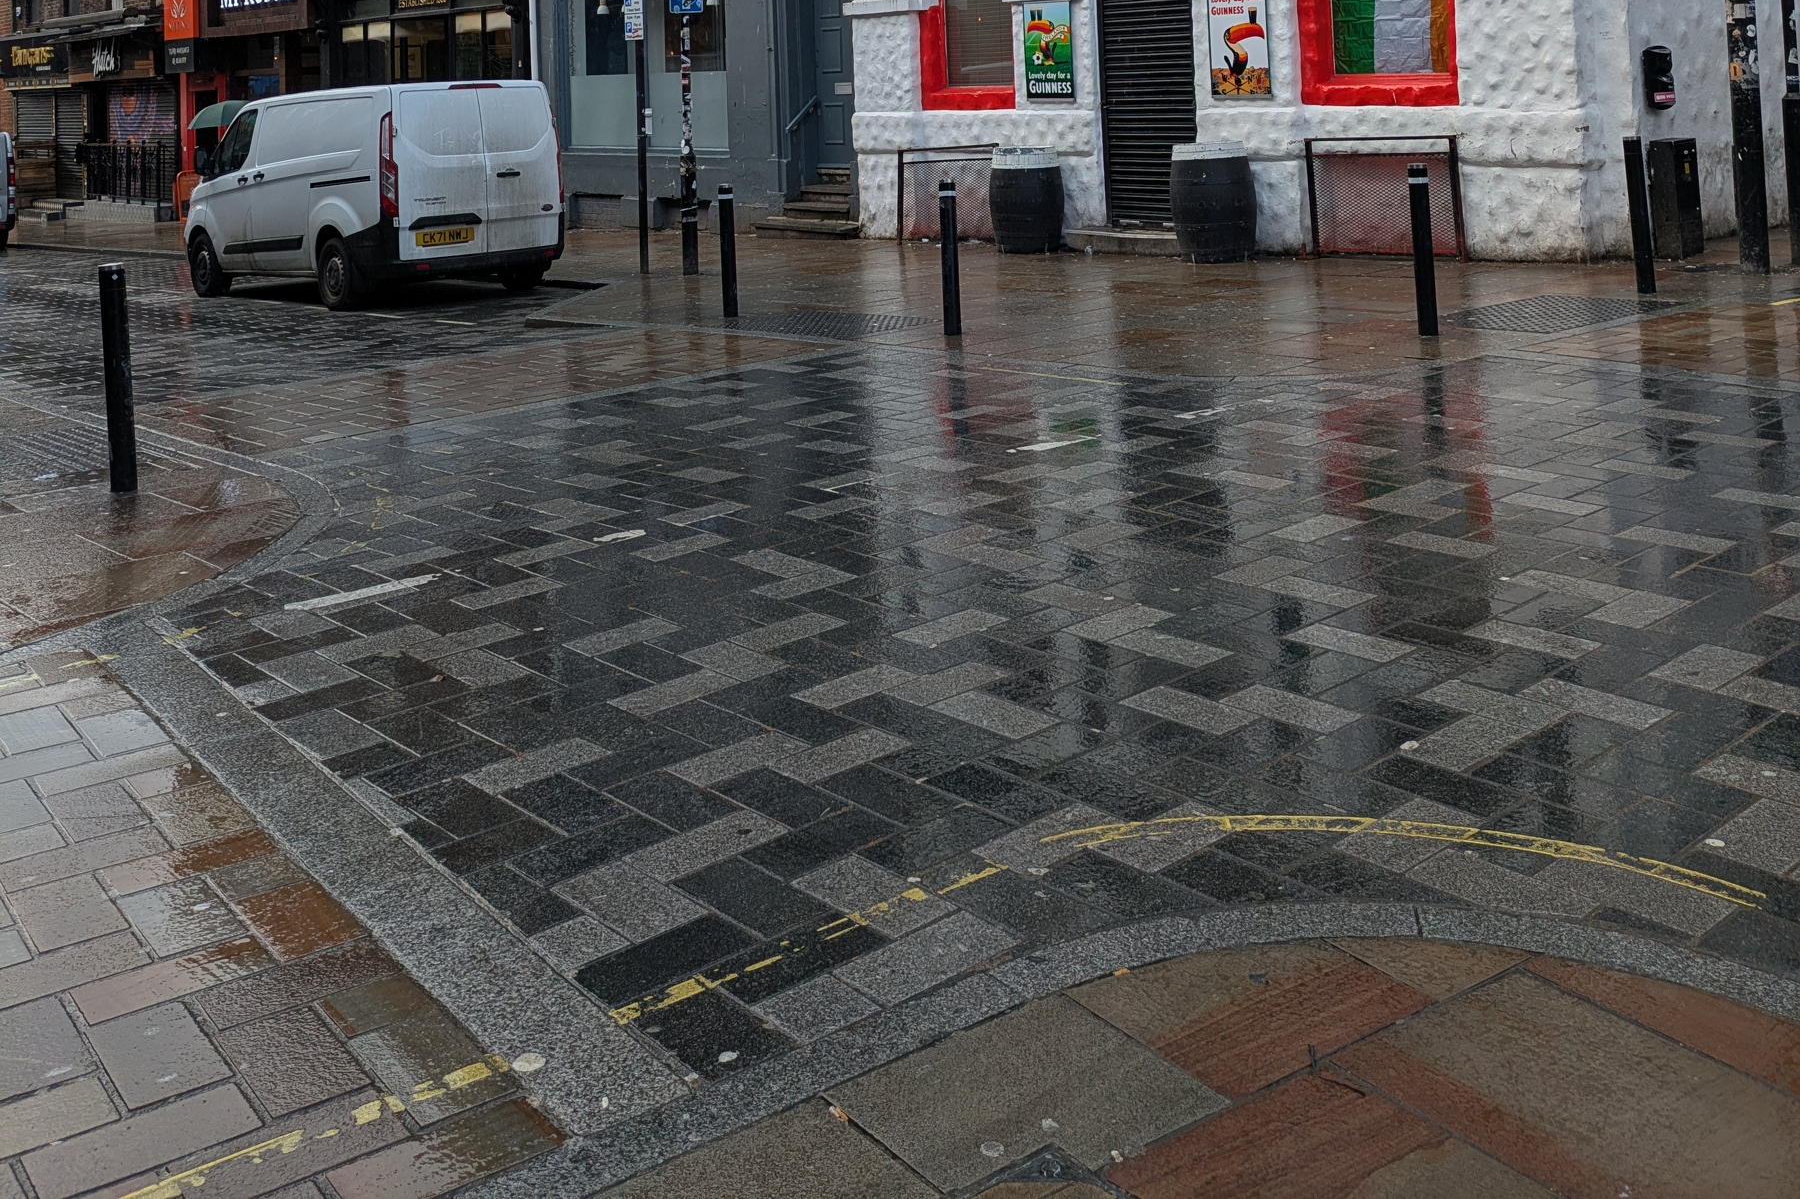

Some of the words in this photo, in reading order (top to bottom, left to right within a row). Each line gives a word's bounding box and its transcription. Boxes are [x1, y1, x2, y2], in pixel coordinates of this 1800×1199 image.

[1211, 5, 1244, 15] GUINNESS
[1028, 71, 1046, 81] Lovely
[1046, 71, 1056, 80] day
[1057, 71, 1065, 79] for
[1029, 80, 1072, 94] GUINNESS
[422, 231, 447, 244] CK71
[449, 229, 469, 241] NWJ
